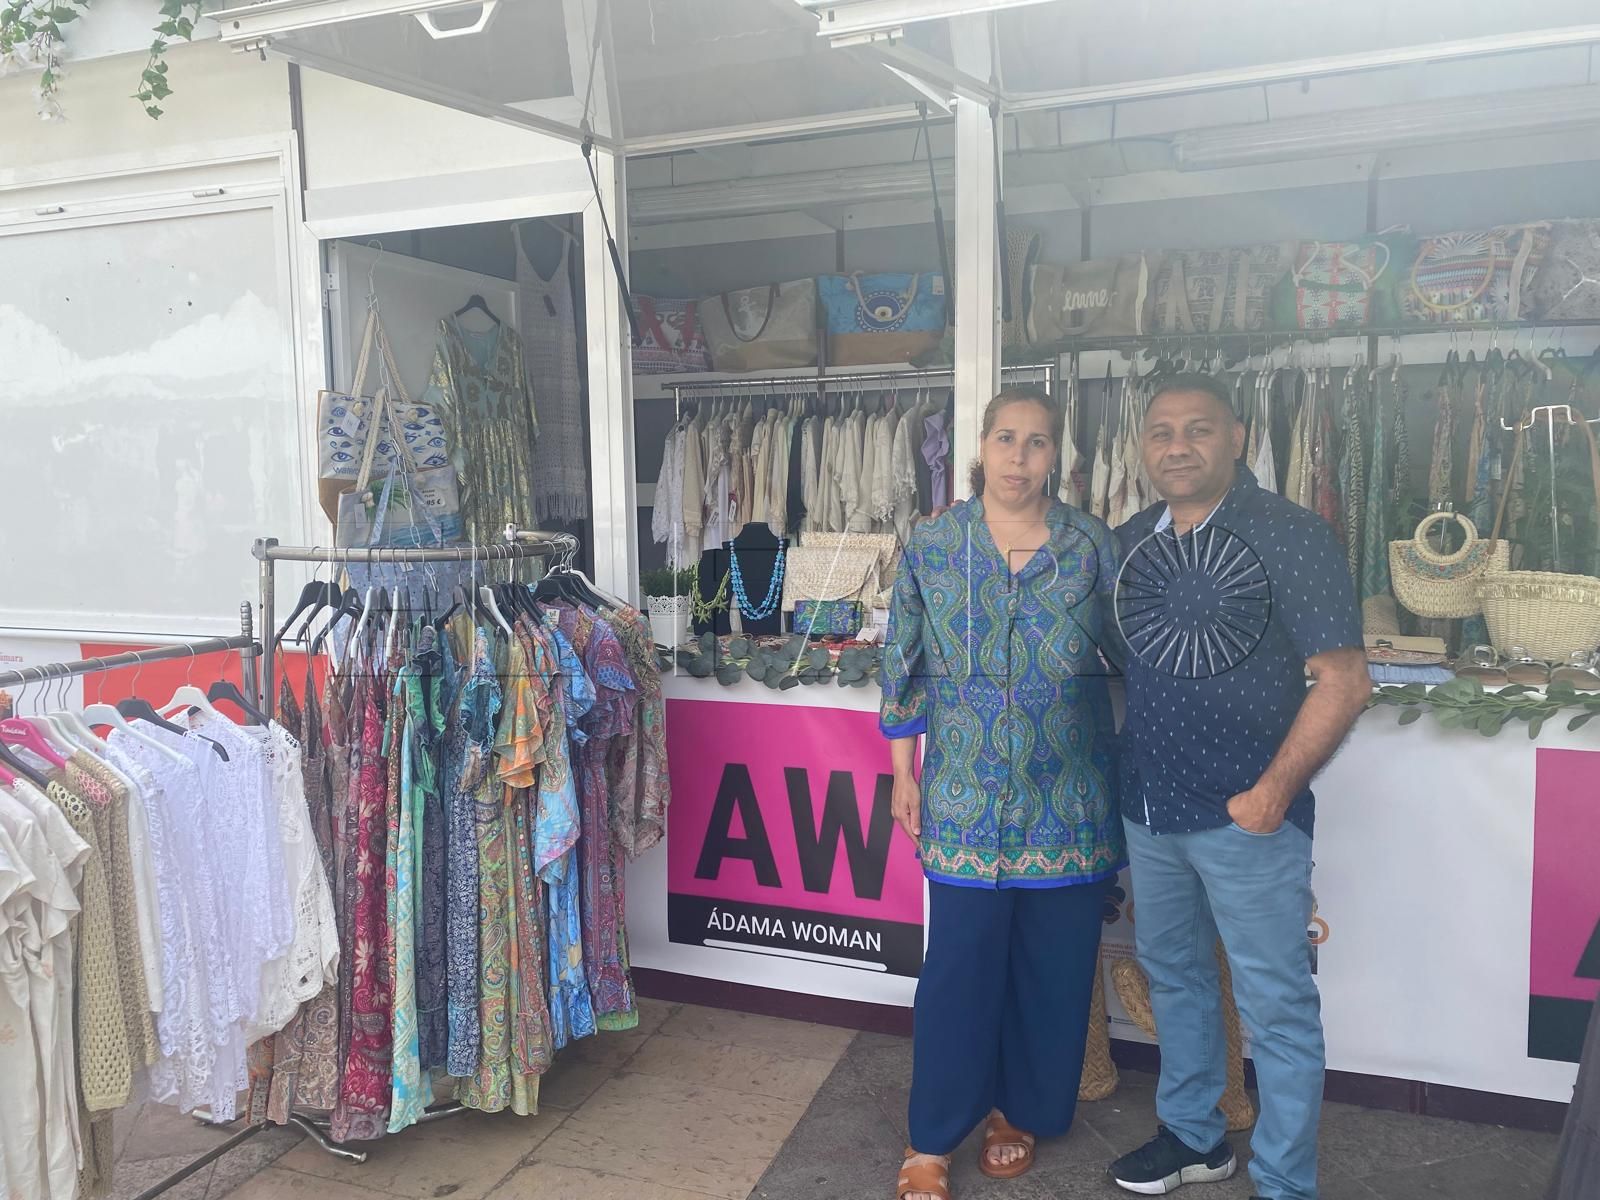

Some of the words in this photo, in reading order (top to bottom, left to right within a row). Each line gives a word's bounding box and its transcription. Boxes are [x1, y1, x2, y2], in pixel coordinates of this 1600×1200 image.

[694, 762, 896, 901] AW
[706, 907, 786, 938] ÁDAMA
[792, 920, 882, 952] WOMAN
